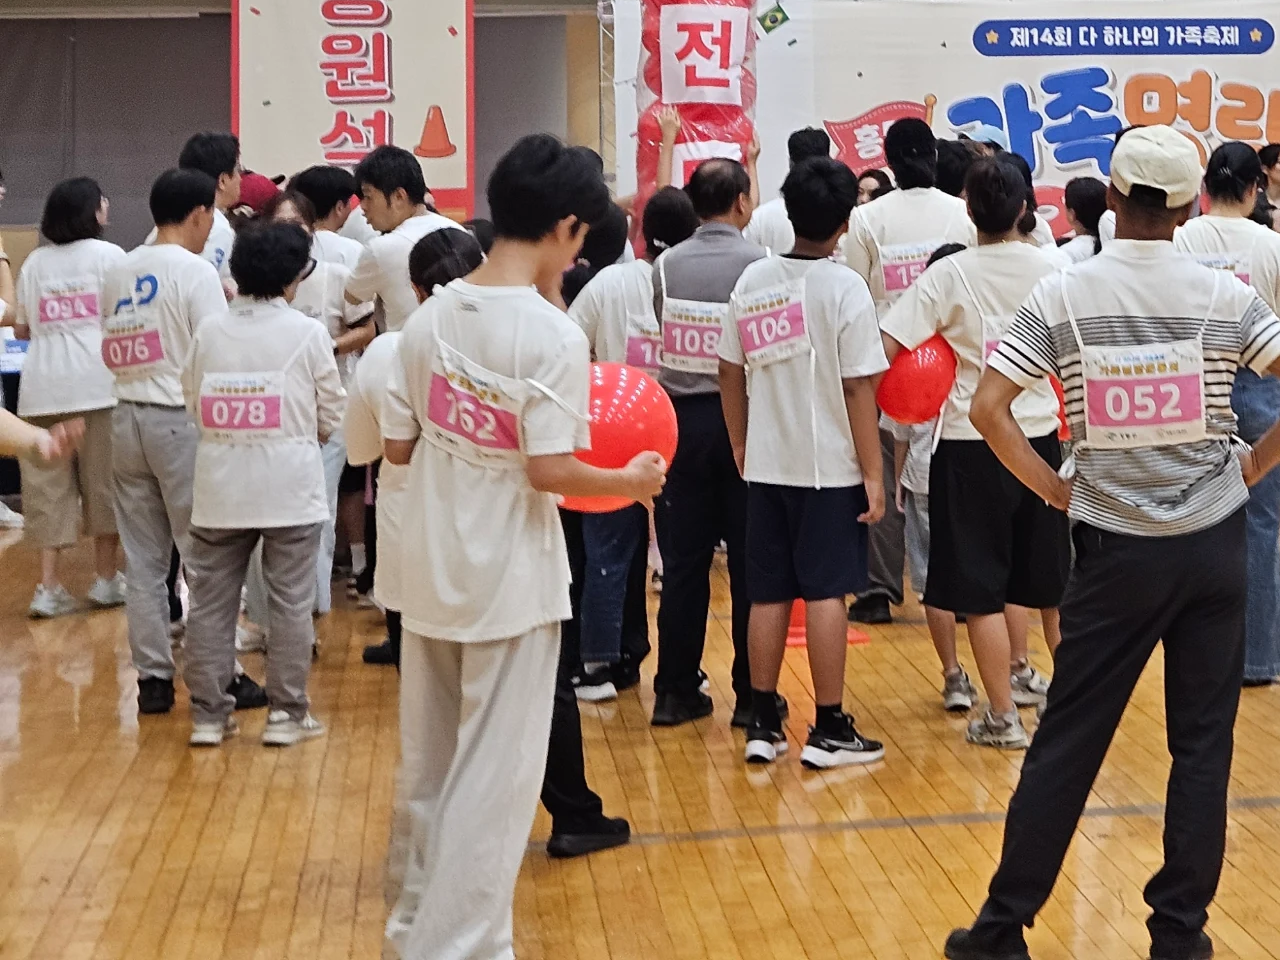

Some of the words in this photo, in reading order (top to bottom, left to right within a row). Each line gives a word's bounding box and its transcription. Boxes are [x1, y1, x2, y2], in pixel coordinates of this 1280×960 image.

[1010, 26, 1072, 48] 제14회
[1077, 26, 1098, 47] 다
[1103, 25, 1159, 47] 하나의
[1167, 25, 1240, 47] 가족축제
[896, 264, 927, 286] 15
[671, 327, 720, 356] 108
[746, 310, 792, 346] 106
[108, 336, 150, 365] 076
[211, 400, 266, 426] 078
[1104, 382, 1182, 421] 052
[445, 392, 498, 442] 162
